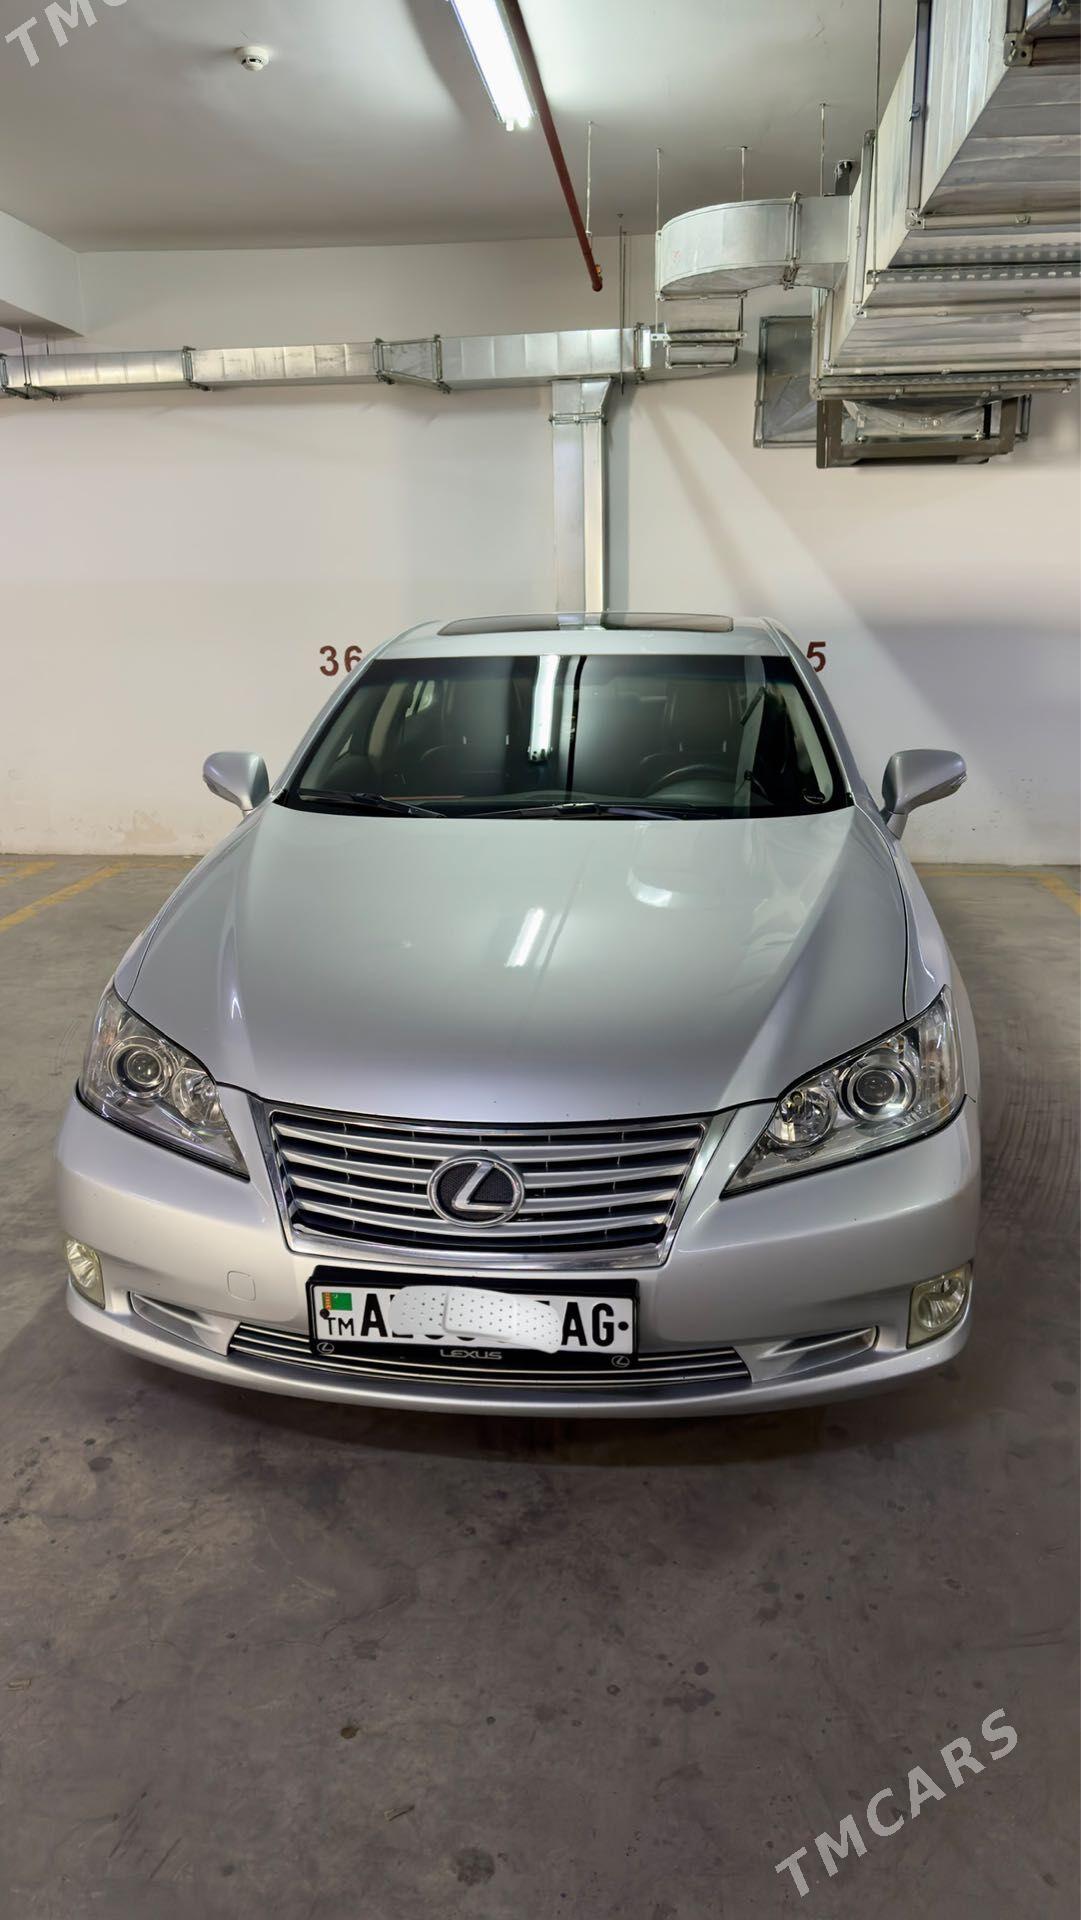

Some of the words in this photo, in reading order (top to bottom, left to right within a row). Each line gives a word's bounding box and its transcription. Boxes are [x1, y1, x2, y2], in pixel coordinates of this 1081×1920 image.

[319, 645, 362, 677] 36
[327, 1317, 355, 1337] TM
[440, 1348, 503, 1360] LEXUS
